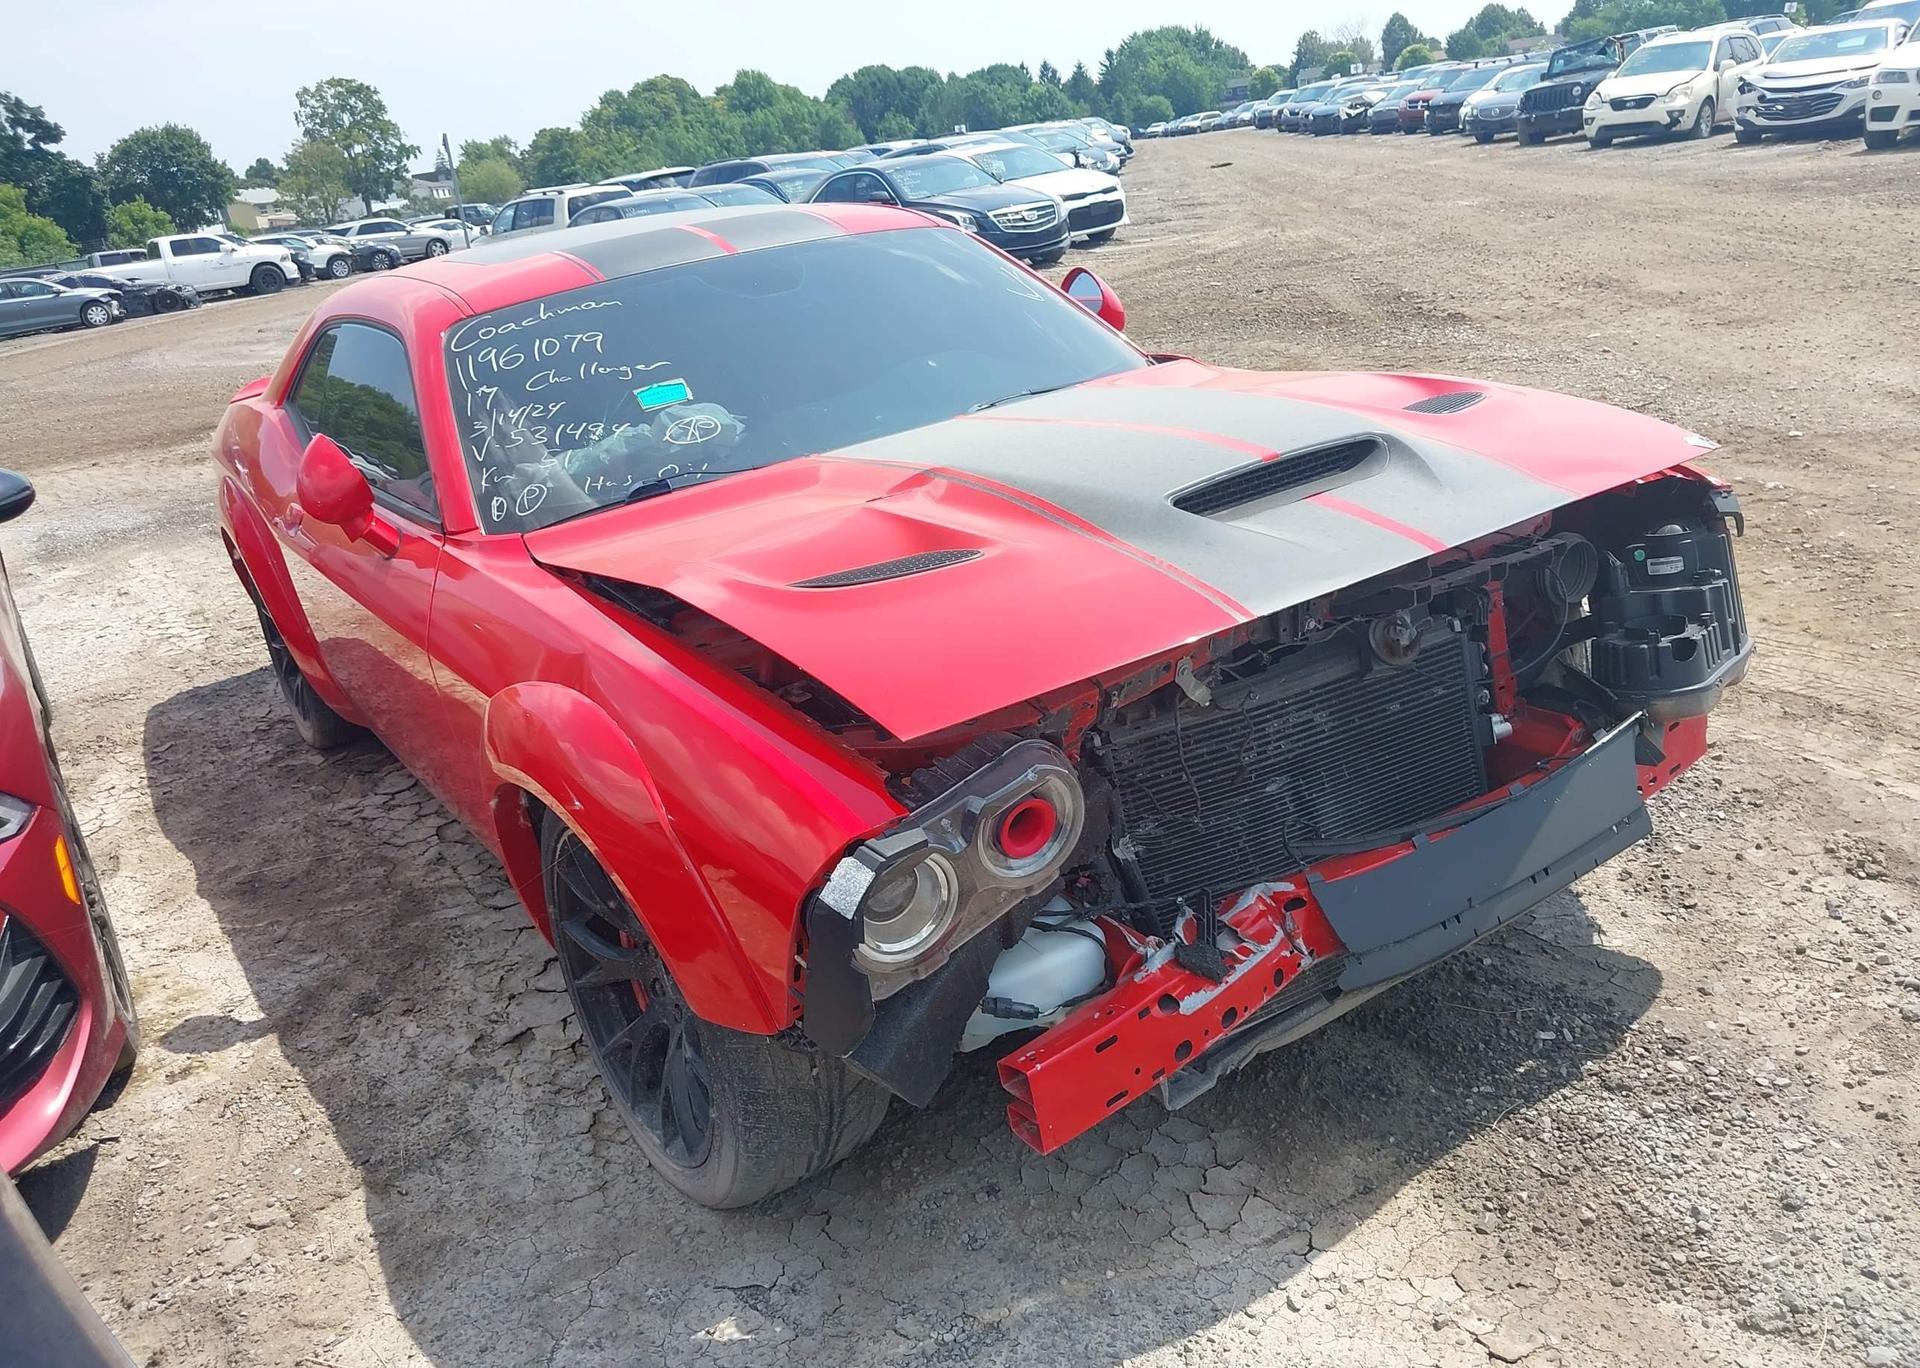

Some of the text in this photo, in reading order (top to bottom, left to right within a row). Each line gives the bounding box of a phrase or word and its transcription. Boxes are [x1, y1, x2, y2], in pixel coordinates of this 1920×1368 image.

[450, 300, 623, 352] Coachman
[525, 360, 672, 392] Challenger
[584, 474, 633, 494] Has
